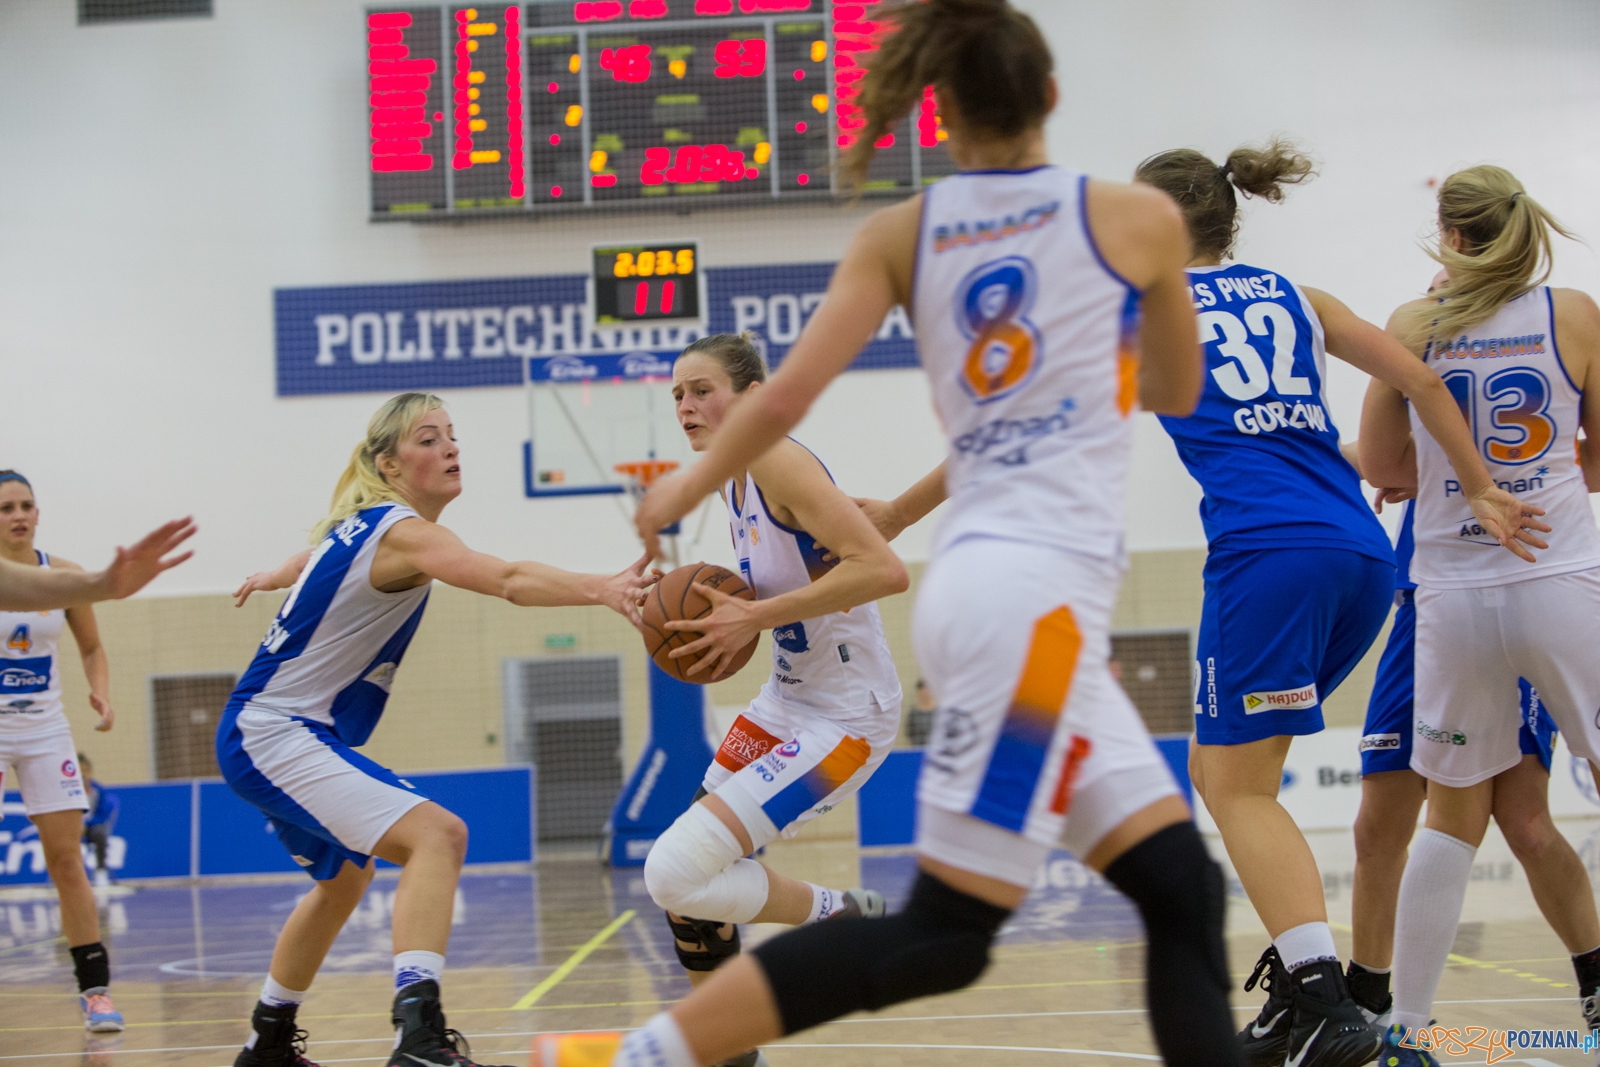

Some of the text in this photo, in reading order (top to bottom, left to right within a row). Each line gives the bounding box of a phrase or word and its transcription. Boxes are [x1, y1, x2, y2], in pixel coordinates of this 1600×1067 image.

[634, 280, 675, 315] 11
[1214, 273, 1286, 303] PWSZ
[954, 254, 1044, 406] 8
[1197, 302, 1313, 402] 32
[7, 624, 32, 654] 4
[2, 673, 48, 687] Enea
[1266, 687, 1315, 706] HAJDUK
